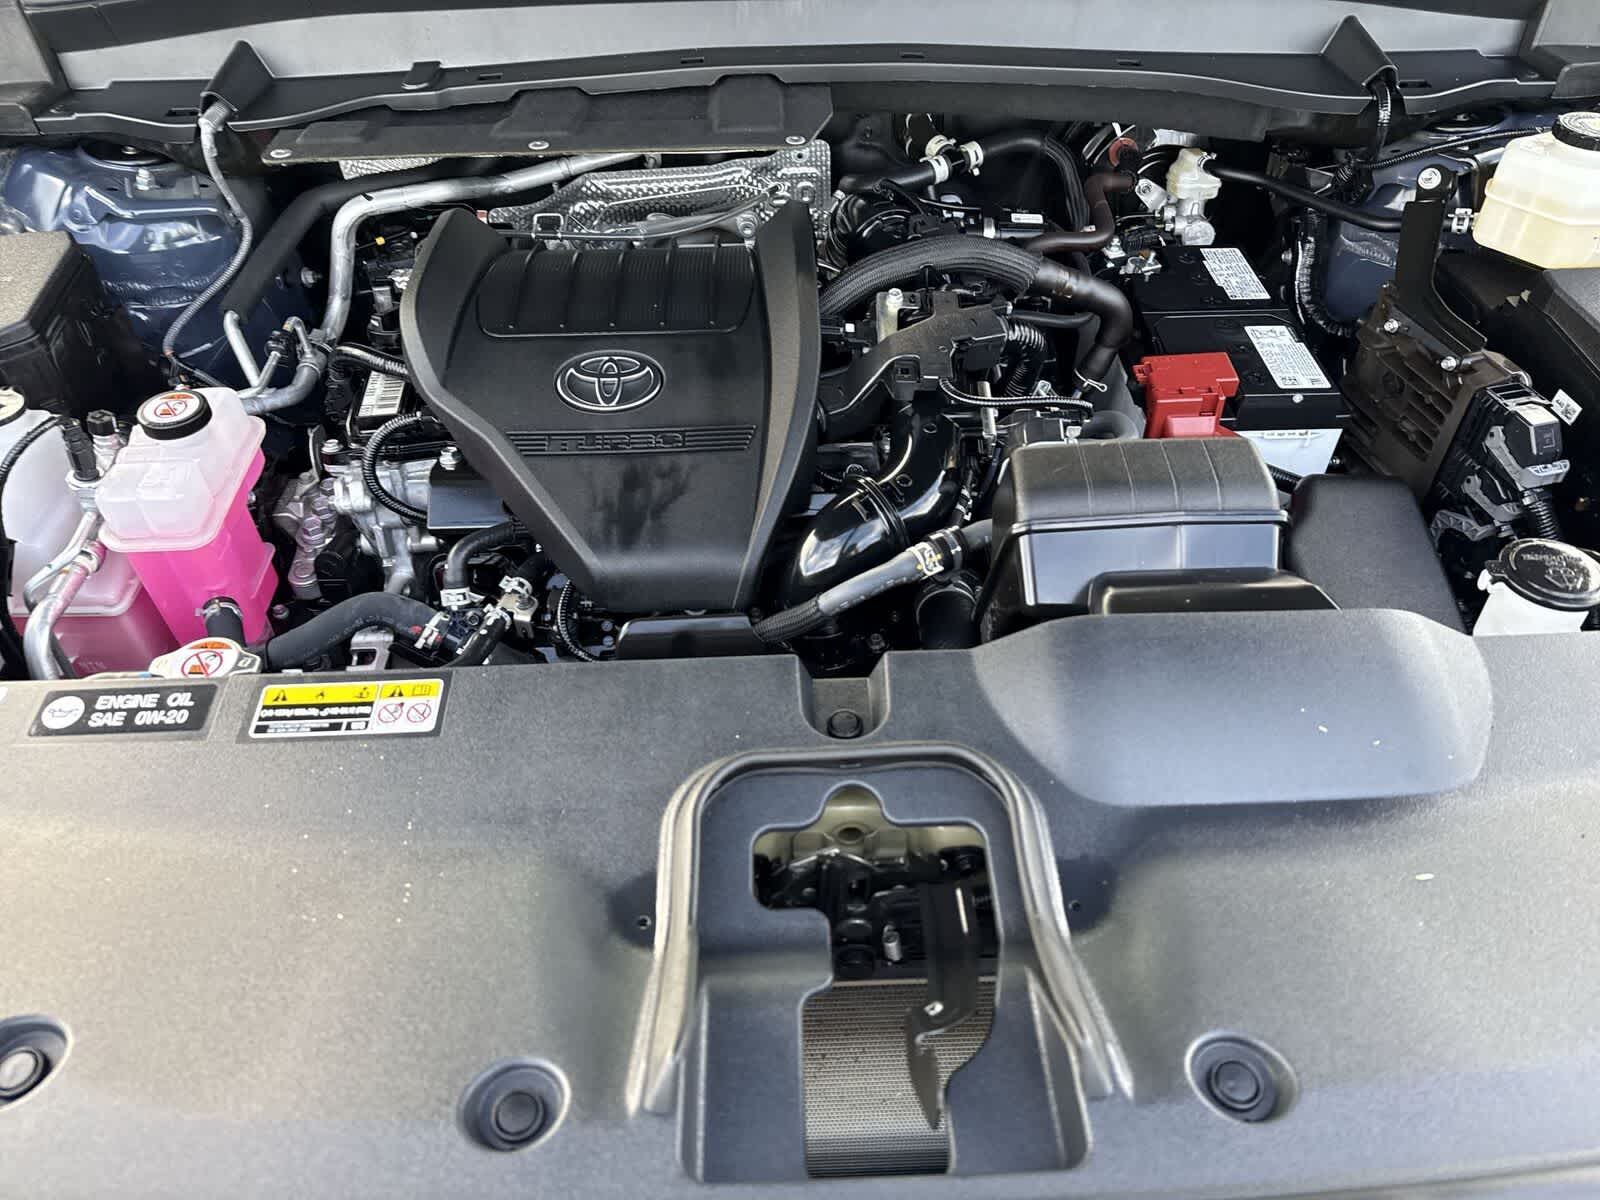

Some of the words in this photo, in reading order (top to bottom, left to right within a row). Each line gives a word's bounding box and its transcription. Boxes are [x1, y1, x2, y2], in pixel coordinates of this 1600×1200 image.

[550, 433, 683, 450] TURBO
[95, 694, 160, 710] ENGINE
[167, 692, 195, 708] OIL
[88, 711, 127, 728] SAE
[134, 710, 189, 726] 0W-20
